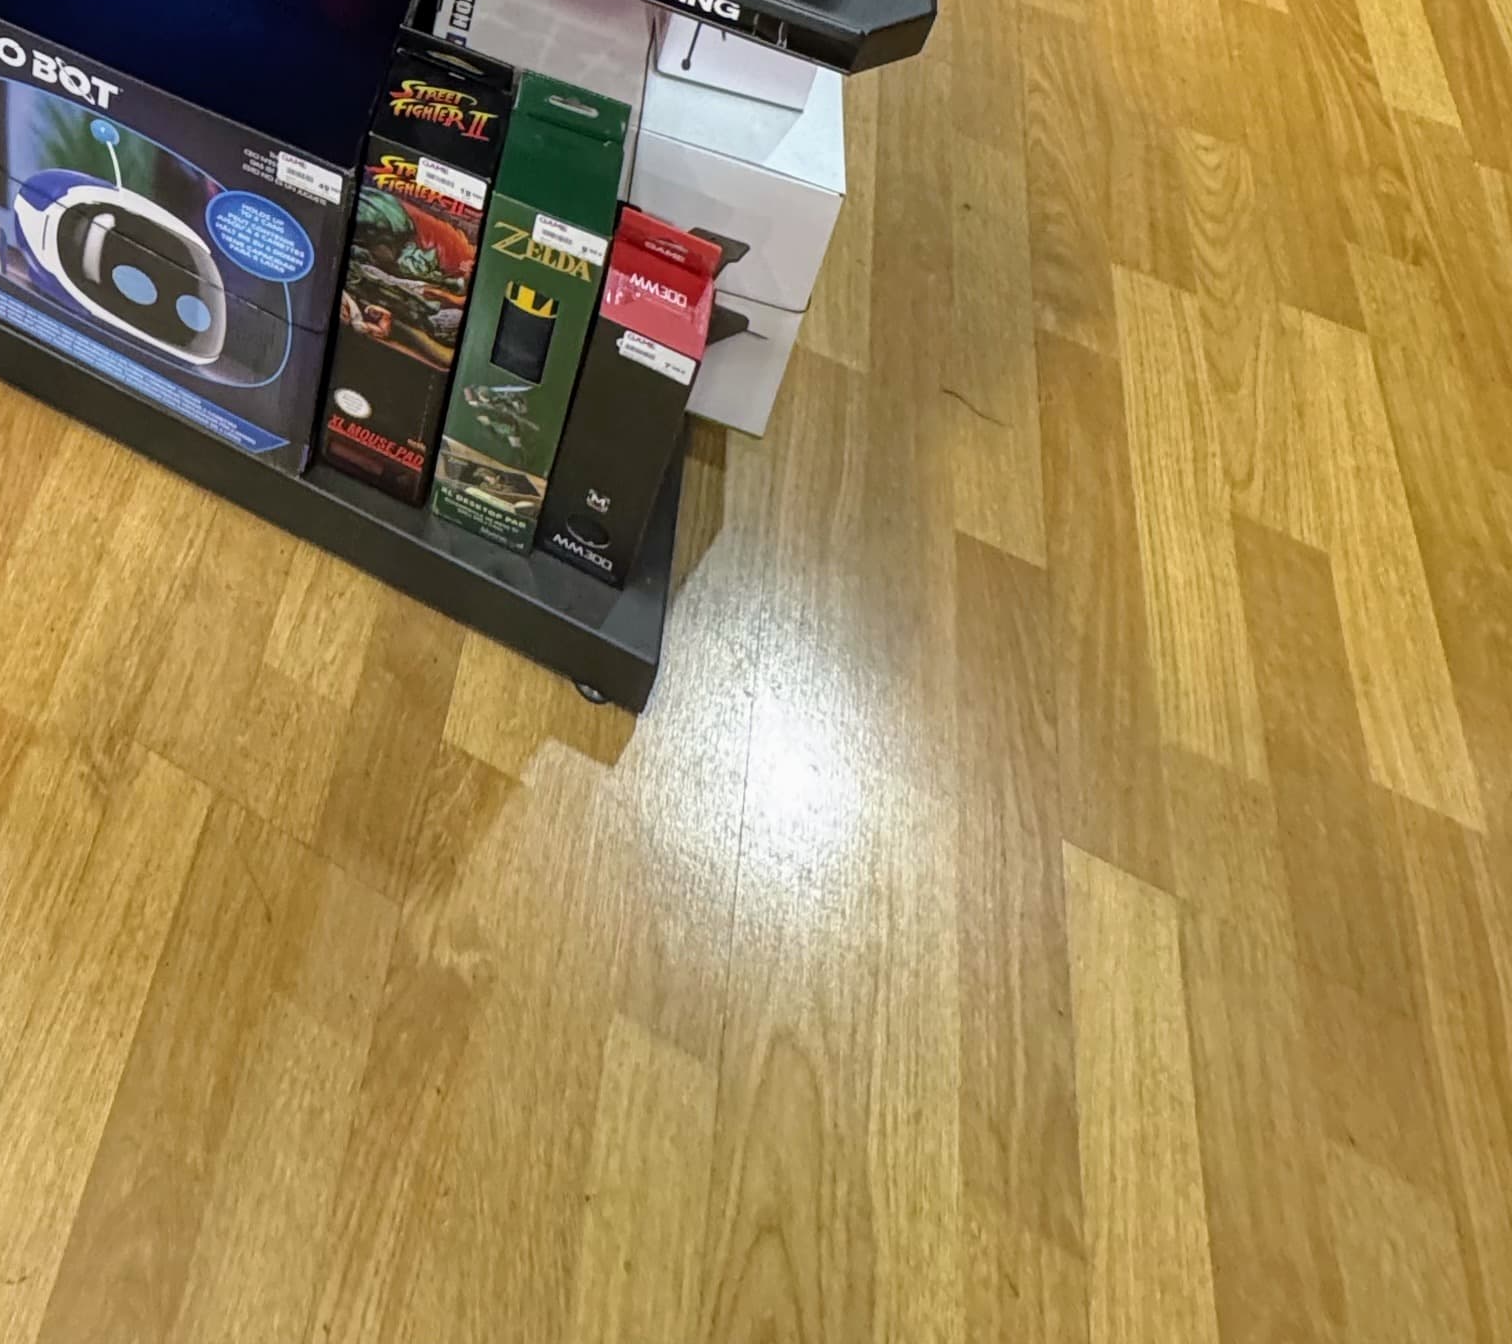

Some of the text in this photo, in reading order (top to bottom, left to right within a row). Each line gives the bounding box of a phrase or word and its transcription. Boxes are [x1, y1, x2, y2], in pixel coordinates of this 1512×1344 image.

[31, 48, 123, 110] BOT
[389, 79, 478, 106] STREET
[389, 97, 499, 143] FIGHTER II
[539, 215, 568, 233] GAME
[491, 220, 591, 283] ZELDA
[644, 240, 686, 263] GAME
[630, 272, 688, 309] MM300
[627, 332, 656, 350] GAME
[328, 414, 425, 469] XL MOUSE PAD
[552, 533, 614, 572] MM300
